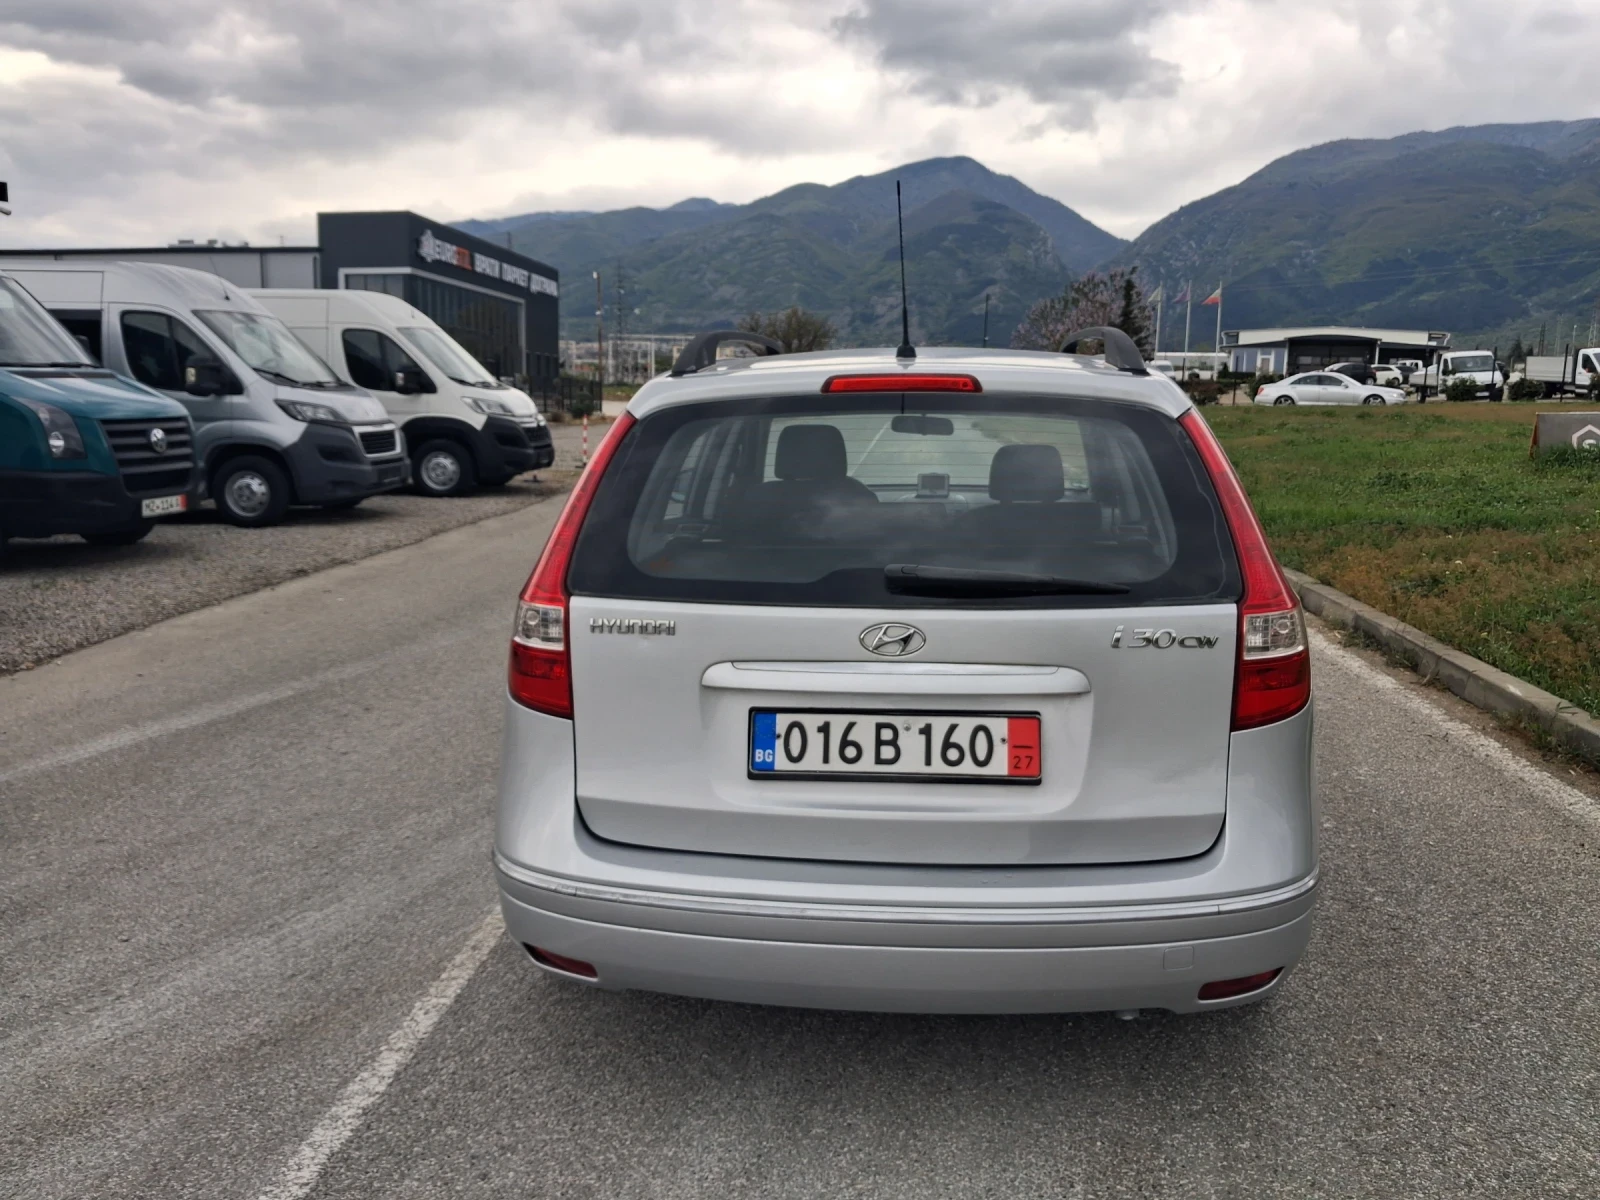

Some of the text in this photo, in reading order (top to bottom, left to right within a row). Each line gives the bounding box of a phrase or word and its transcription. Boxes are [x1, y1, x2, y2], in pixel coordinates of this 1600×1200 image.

[589, 617, 676, 636] HYUNDAI
[755, 749, 773, 762] BG
[1013, 755, 1033, 769] 27
